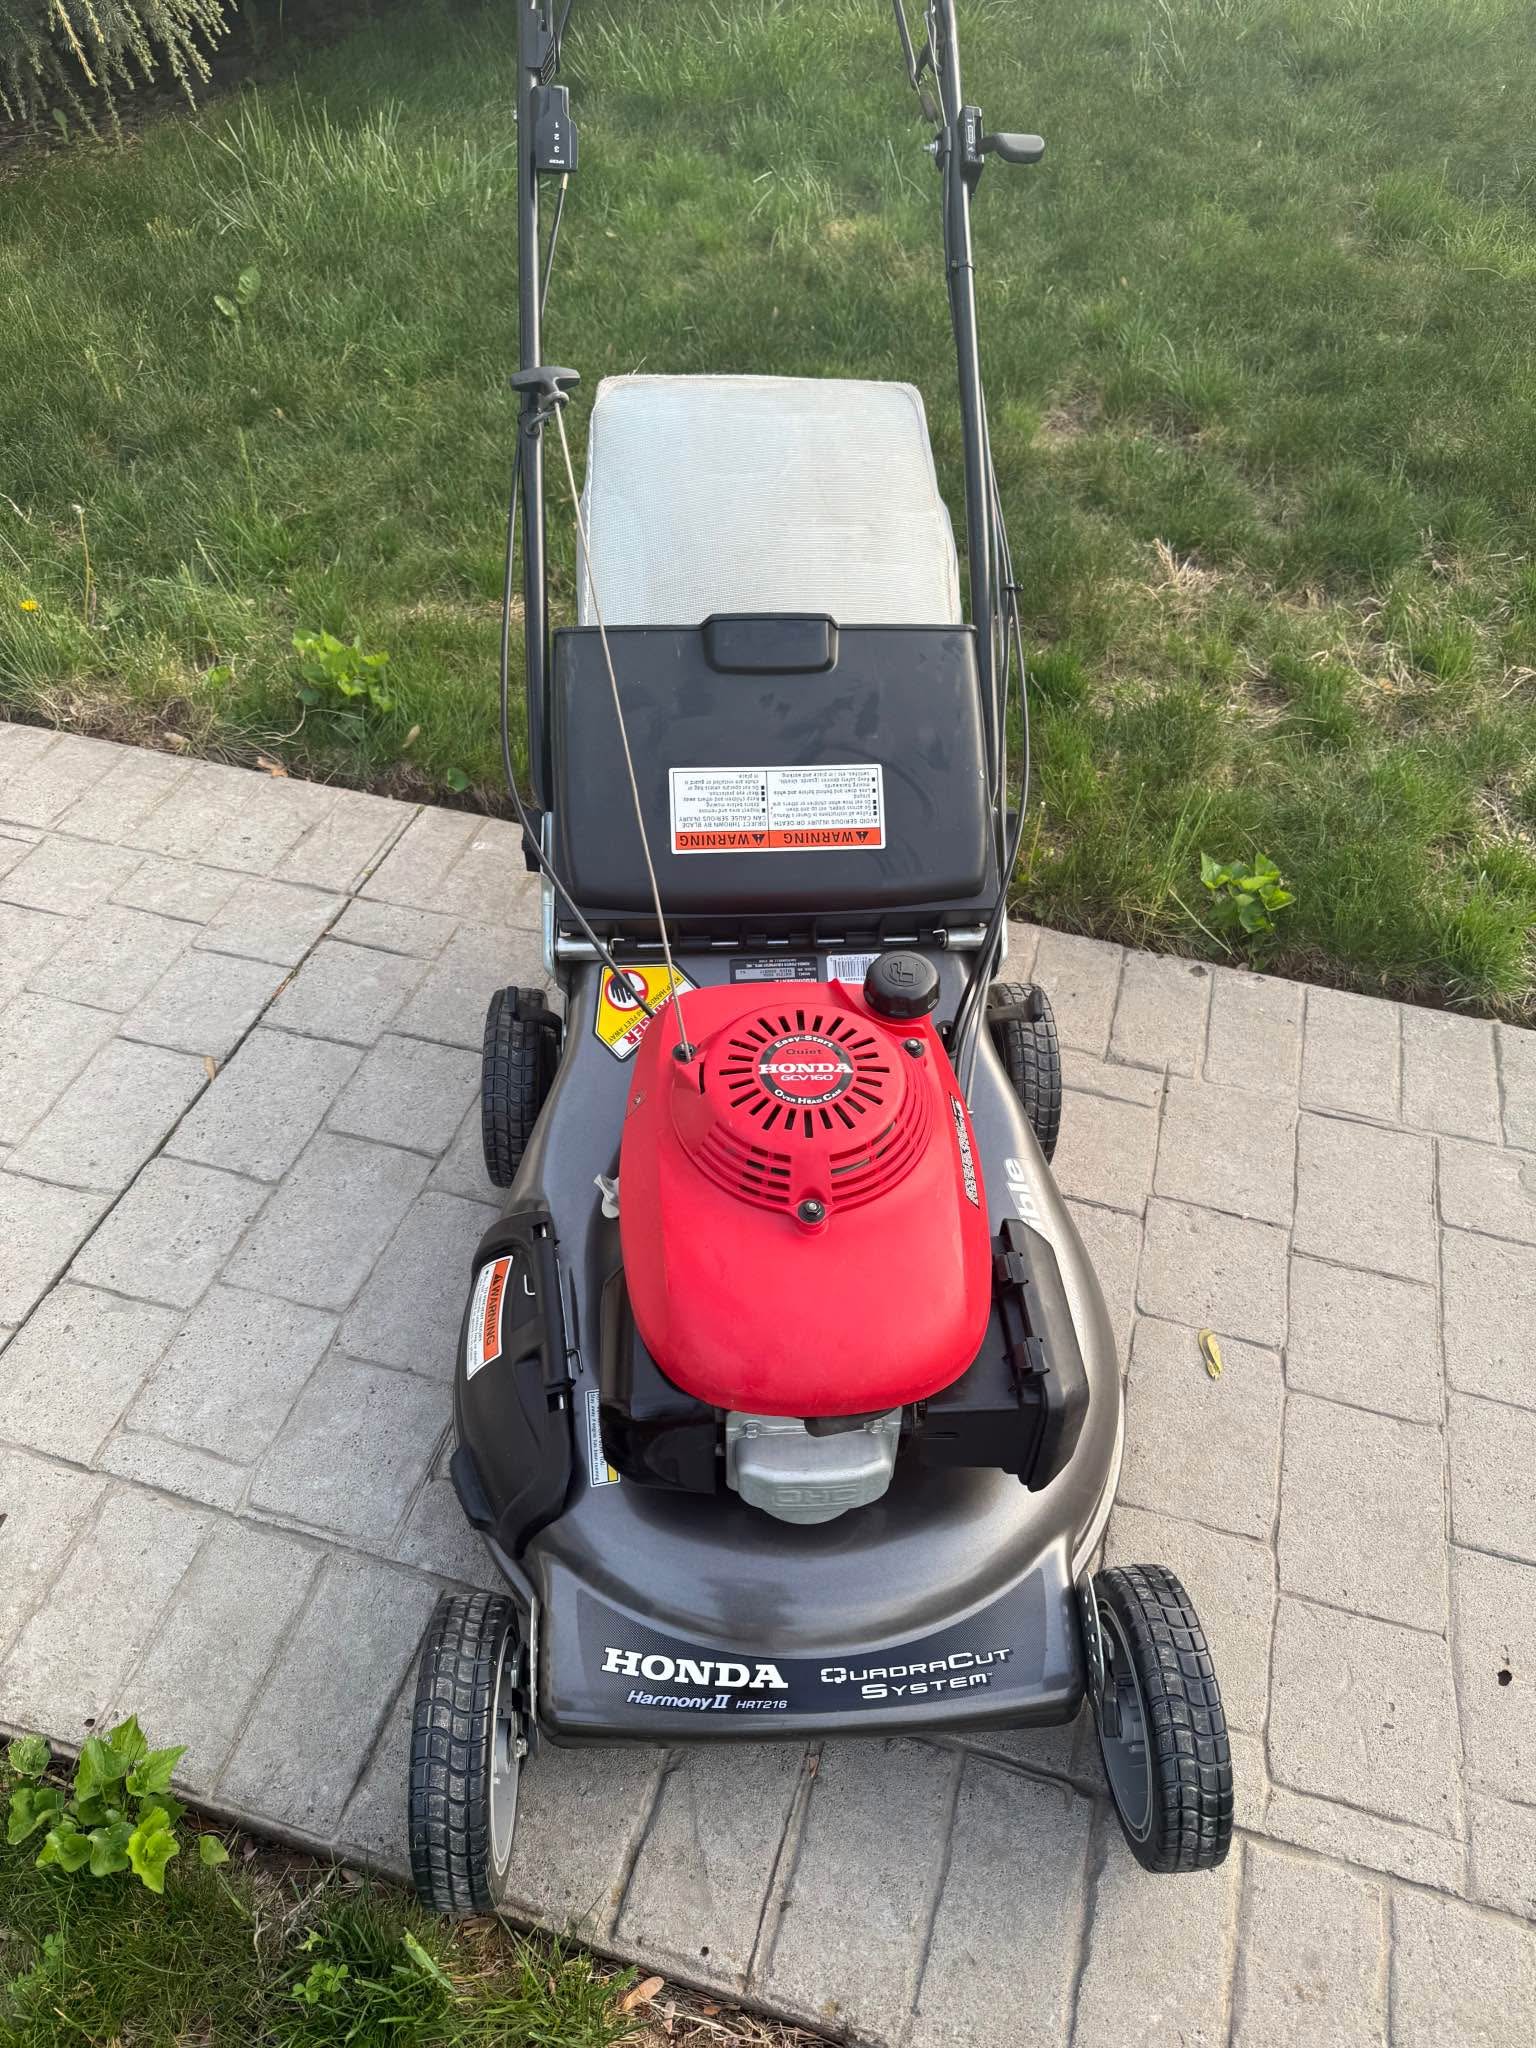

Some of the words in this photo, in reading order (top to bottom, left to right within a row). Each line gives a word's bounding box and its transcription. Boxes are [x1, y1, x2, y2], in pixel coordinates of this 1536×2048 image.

[680, 834, 749, 846] WARNING
[784, 832, 853, 843] WARNING
[608, 1028, 624, 1042] AWAY
[786, 1047, 822, 1056] Quiet
[758, 1062, 854, 1074] HONDA
[486, 1286, 500, 1346] WARNING
[601, 1647, 789, 1690] HONDA
[626, 1690, 714, 1710] Harmony
[736, 1699, 788, 1710] HRT216
